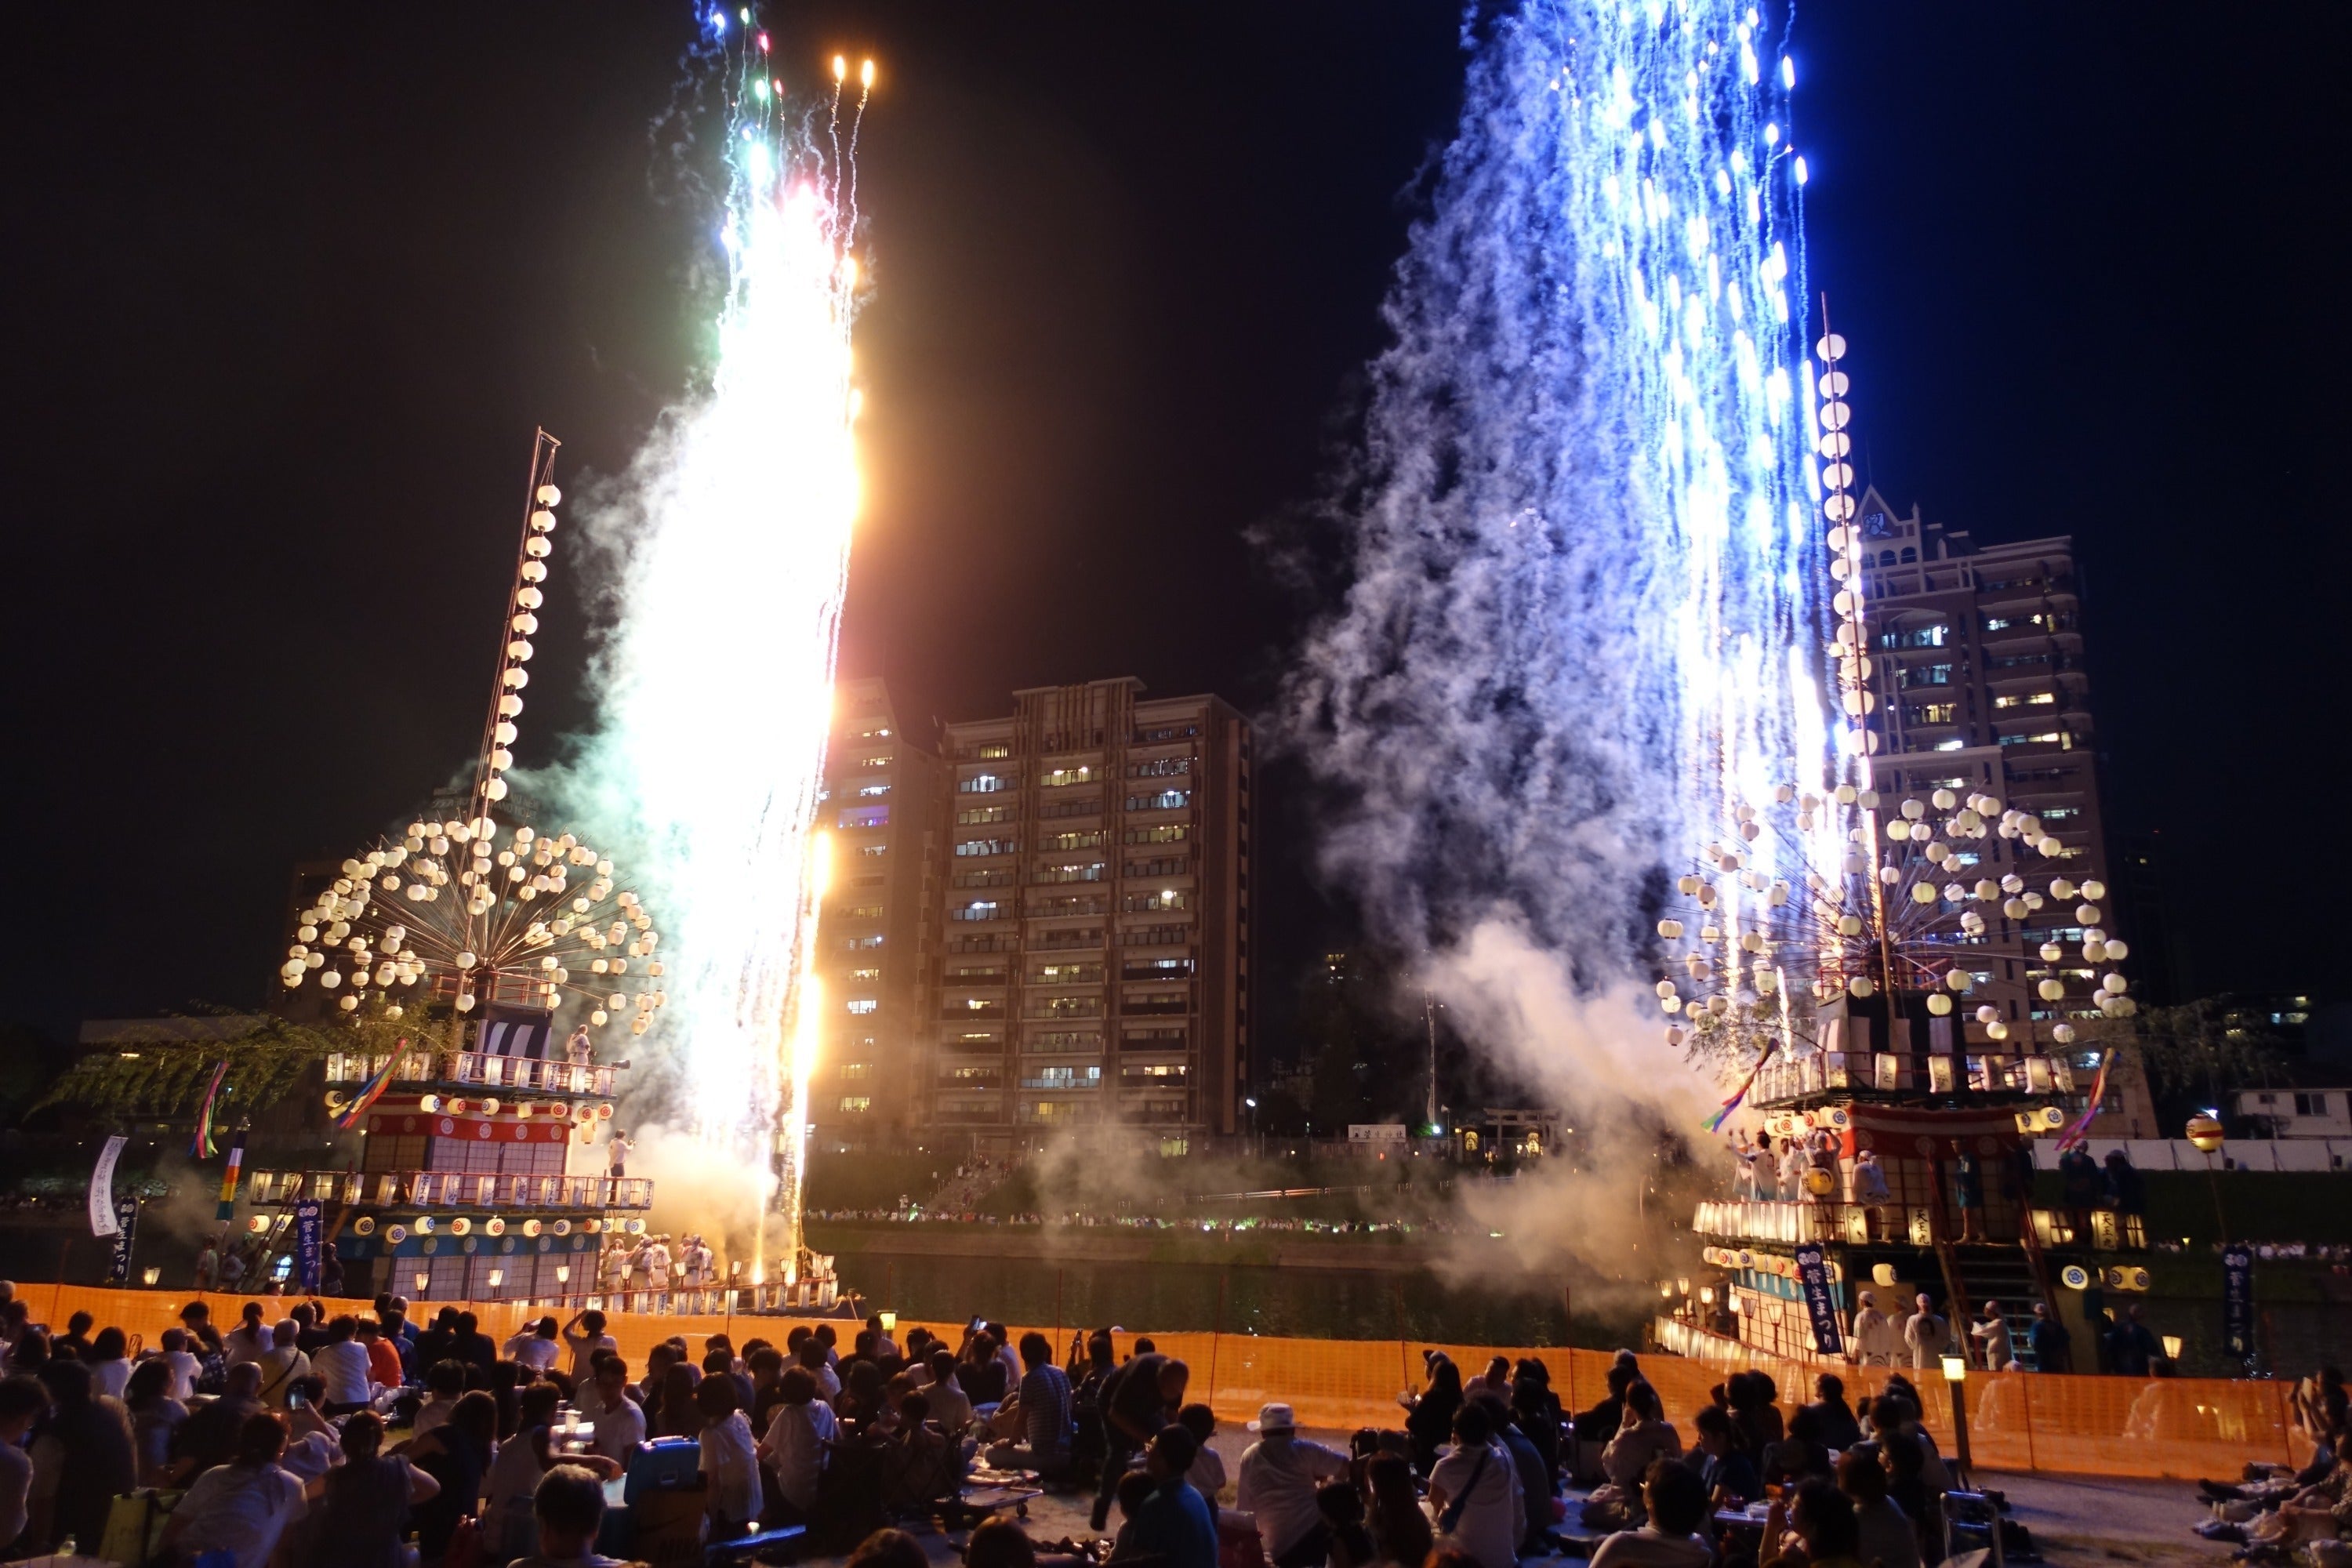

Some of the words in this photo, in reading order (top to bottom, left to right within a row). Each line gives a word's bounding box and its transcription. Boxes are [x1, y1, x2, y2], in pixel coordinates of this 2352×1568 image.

[303, 1220, 316, 1279] 菅生まつり
[1915, 1209, 1929, 1244] 天王丸
[2101, 1214, 2115, 1248] 天王丸
[1806, 1269, 1832, 1348] 菅生まつり
